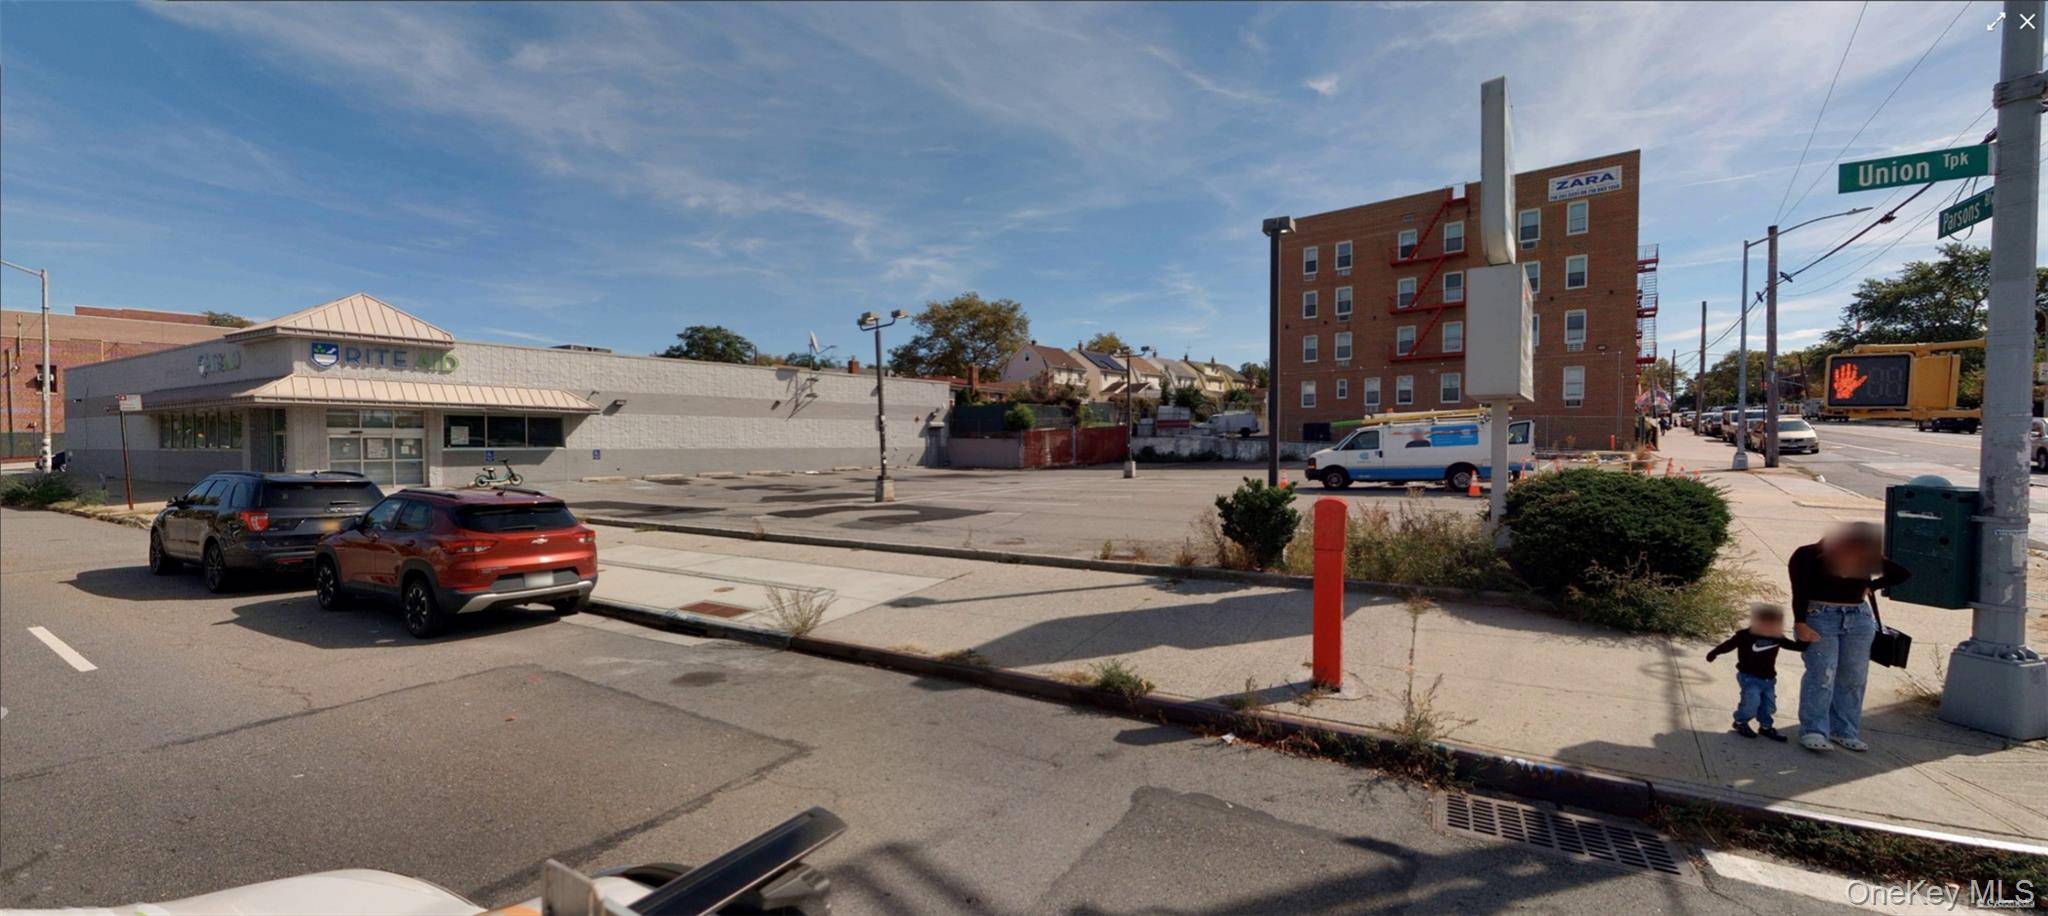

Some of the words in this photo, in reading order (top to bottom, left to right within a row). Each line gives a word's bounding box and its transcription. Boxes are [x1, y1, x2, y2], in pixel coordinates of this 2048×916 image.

[1556, 173, 1614, 190] ZARA
[1859, 161, 1930, 187] Union
[1943, 153, 1969, 170] Tpk
[1943, 202, 1980, 233] Parsons
[345, 347, 407, 369] RITE
[415, 351, 460, 373] AID
